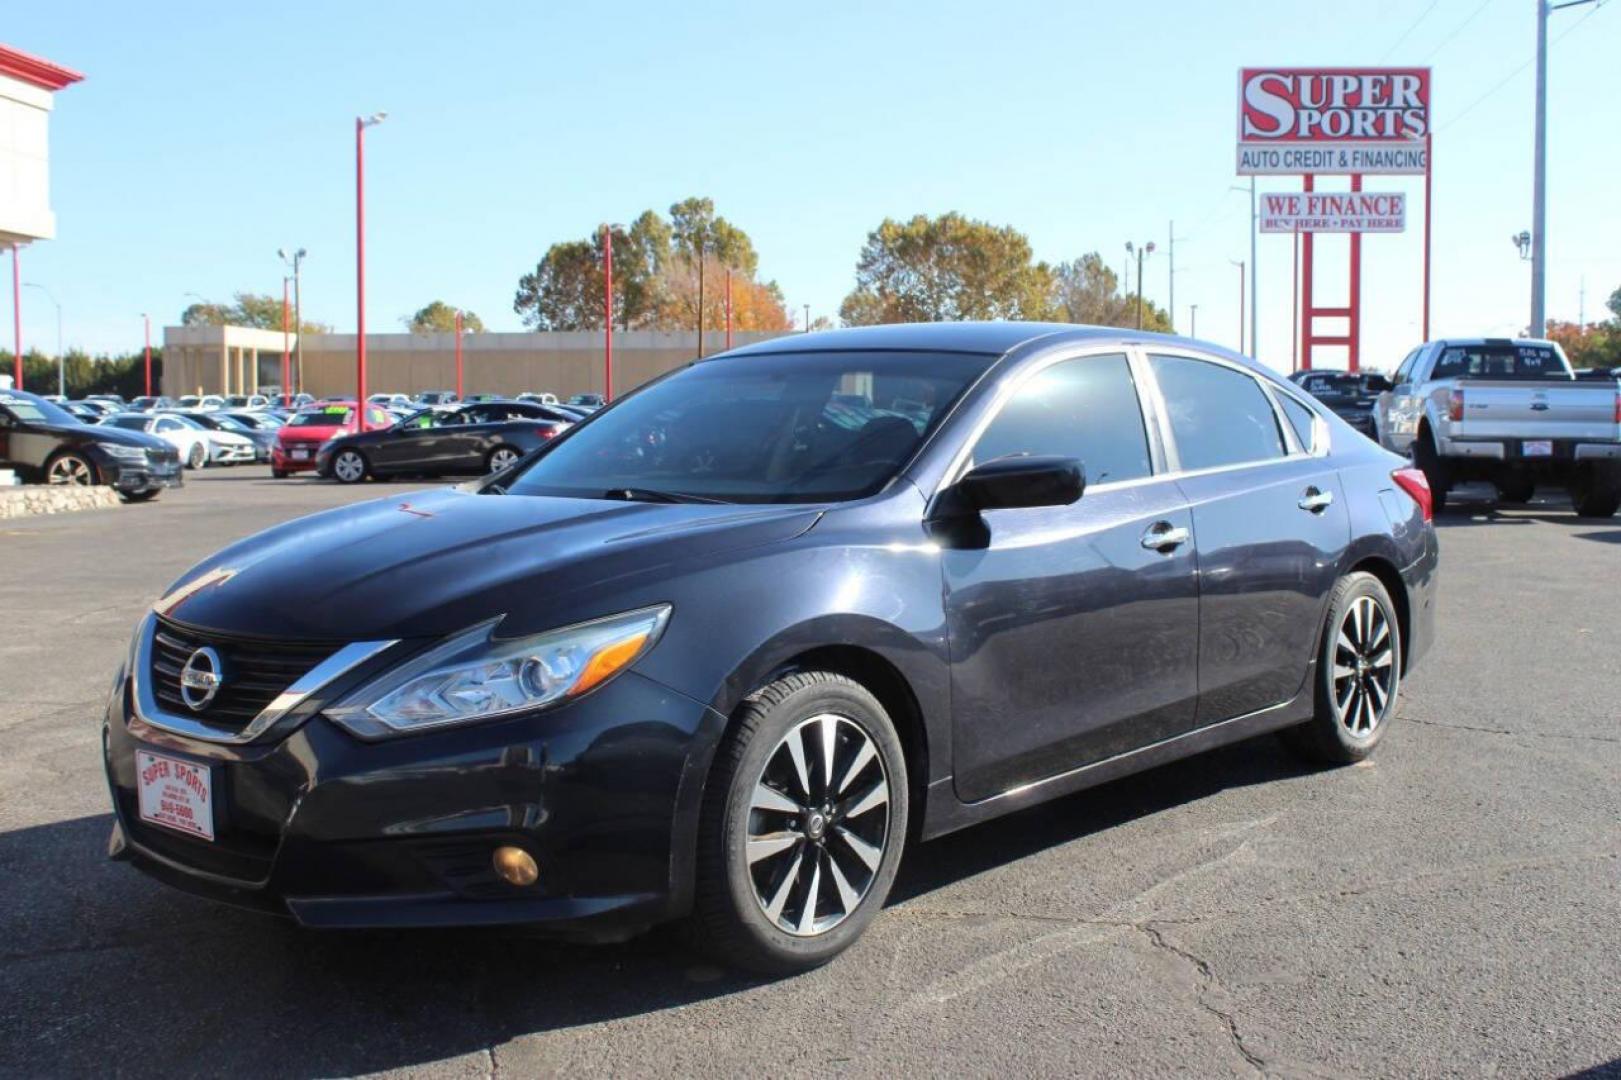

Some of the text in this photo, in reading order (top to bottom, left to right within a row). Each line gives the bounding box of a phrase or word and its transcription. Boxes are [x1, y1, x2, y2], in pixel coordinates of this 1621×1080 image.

[1245, 73, 1426, 110] SUPER
[1245, 104, 1426, 138] SPORTS
[1241, 151, 1280, 168] AUTO
[1283, 151, 1334, 168] CREDIT
[1339, 151, 1348, 168] &
[1266, 195, 1403, 216] WE FINANCE
[1295, 219, 1330, 228] HERE
[1340, 219, 1362, 228] PAY
[1367, 219, 1404, 228] HERE
[142, 760, 170, 786] SUPER
[175, 762, 208, 803] SPORTS
